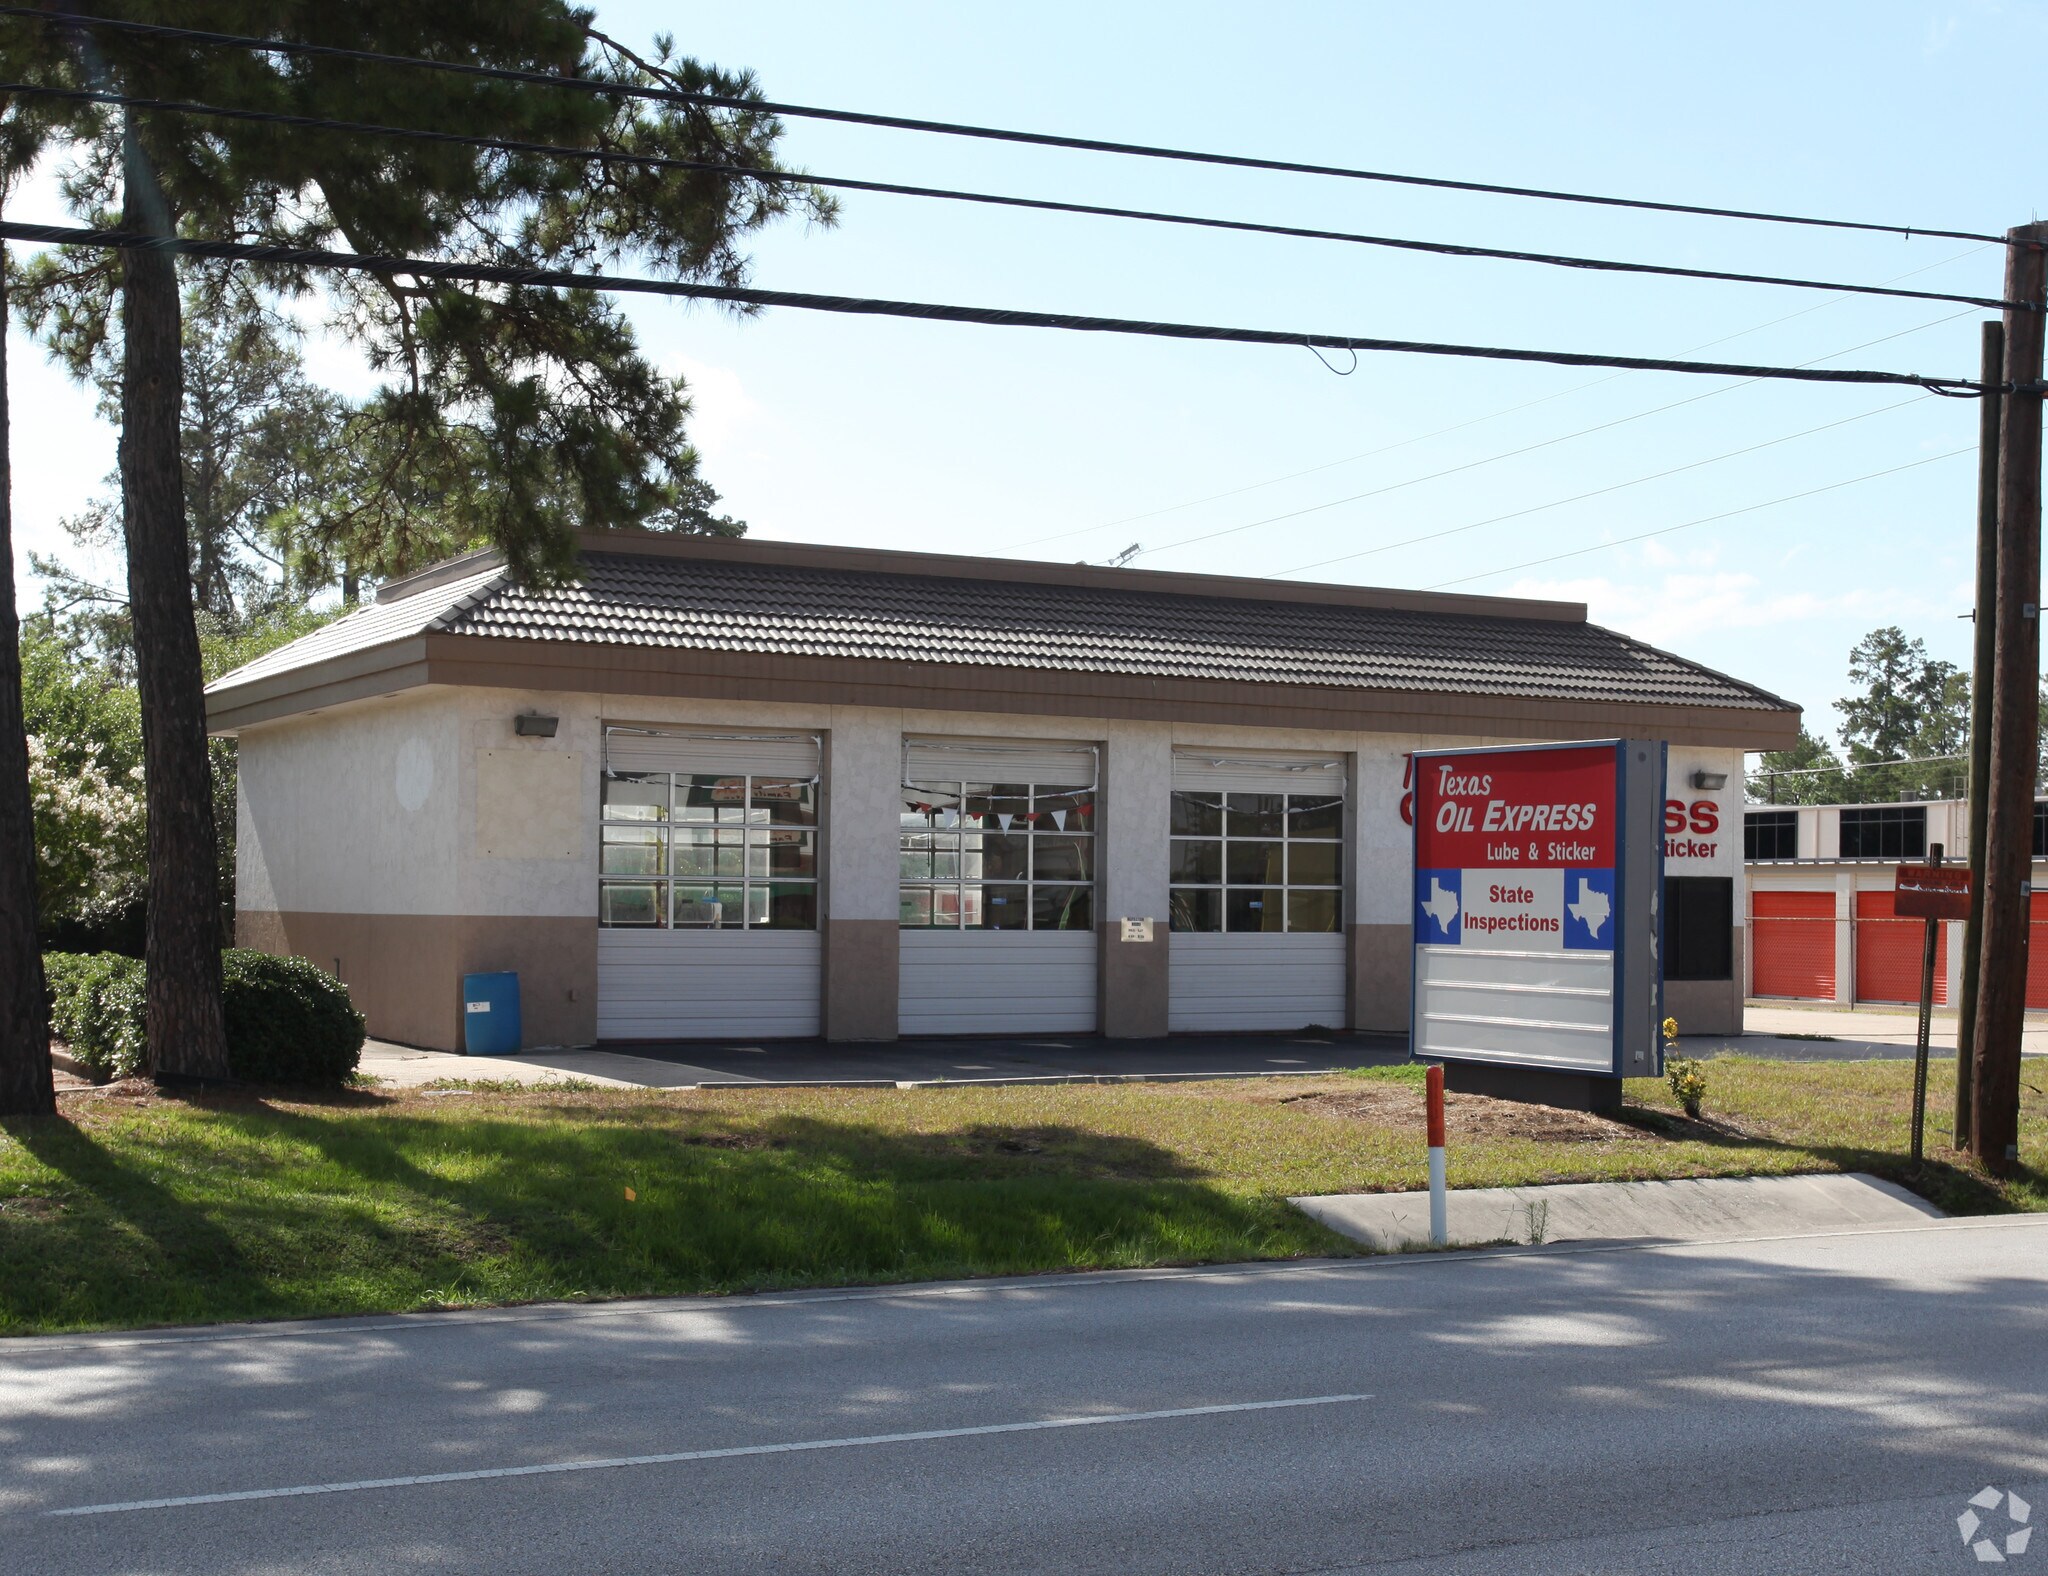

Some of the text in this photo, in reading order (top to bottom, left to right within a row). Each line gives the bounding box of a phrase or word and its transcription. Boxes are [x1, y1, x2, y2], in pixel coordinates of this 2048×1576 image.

[1438, 764, 1492, 797] Texas
[1435, 800, 1475, 833] OIL
[1481, 799, 1597, 832] EXPRESS
[1487, 841, 1596, 861] Lube & Sticker
[1664, 838, 1718, 858] ticker
[1489, 884, 1534, 904] State
[1464, 911, 1560, 934] Inspections
